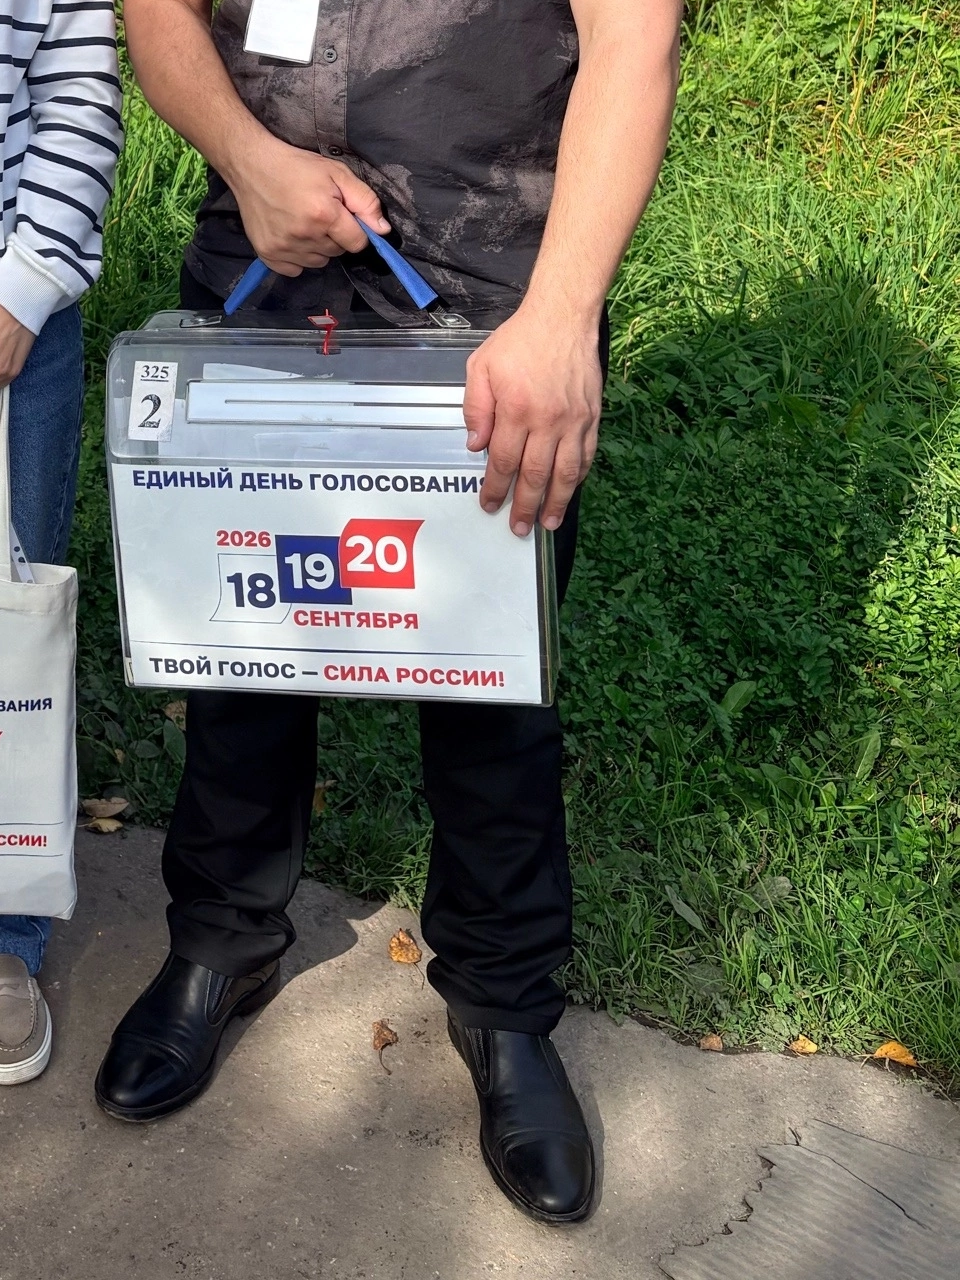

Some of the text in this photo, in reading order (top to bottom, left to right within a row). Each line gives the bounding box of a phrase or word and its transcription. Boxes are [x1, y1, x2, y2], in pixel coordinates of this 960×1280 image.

[141, 365, 169, 380] 325
[138, 394, 161, 428] 2
[133, 468, 486, 494] ЕДИНЫЙ ДЕНЬ ГОЛОСОВАНИ
[217, 530, 271, 547] 2026
[227, 536, 407, 608] 18 19 20
[294, 610, 418, 629] СЕНТЯБРЯ
[149, 656, 211, 675] ТВОЙ
[218, 661, 295, 678] ГОЛОС
[324, 665, 389, 682] СИЛА
[397, 668, 504, 687] РОССИИ!
